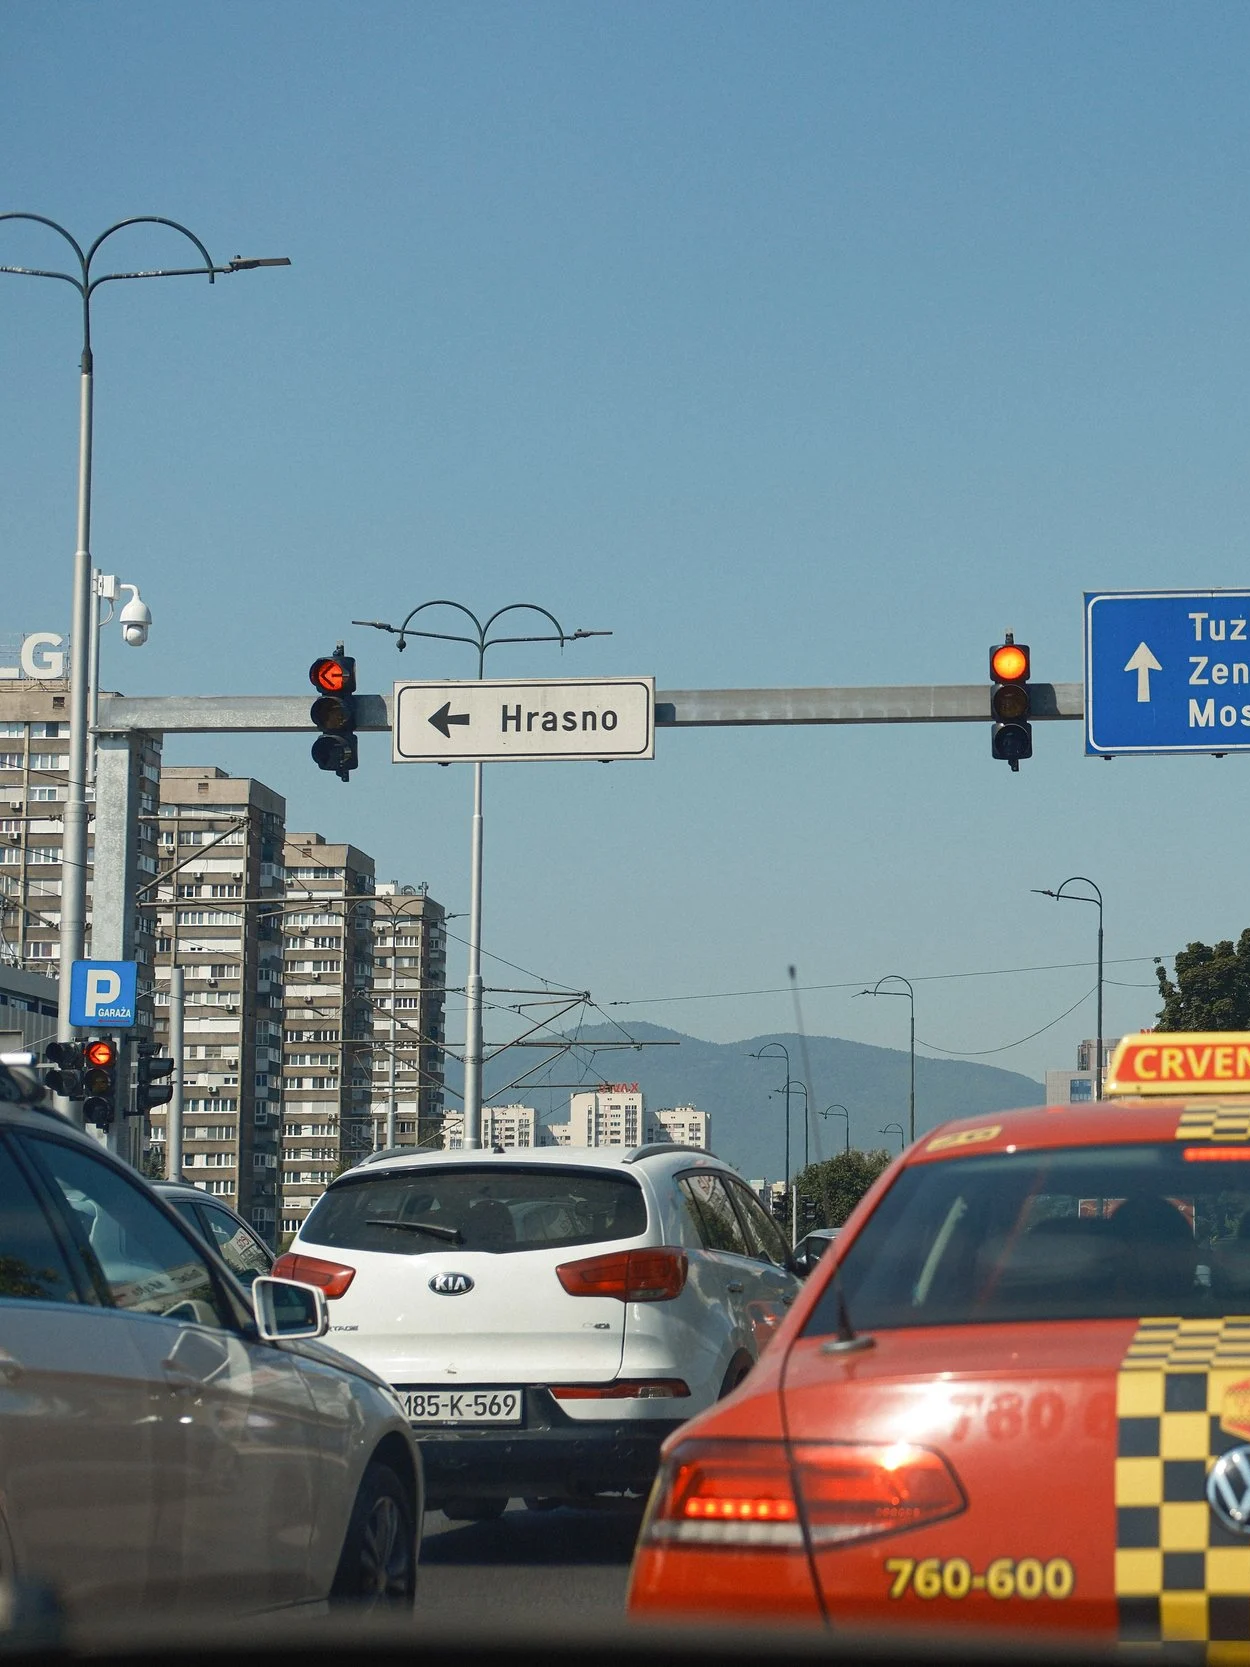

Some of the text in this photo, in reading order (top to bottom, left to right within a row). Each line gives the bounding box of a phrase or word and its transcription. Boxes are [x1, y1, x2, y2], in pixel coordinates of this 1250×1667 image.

[0, 632, 64, 680] G
[501, 703, 618, 732] Hrasno
[85, 969, 121, 1017] P
[98, 1006, 131, 1018] GARAŽA
[435, 1275, 467, 1291] KIA
[885, 1556, 1075, 1601] 760-600
